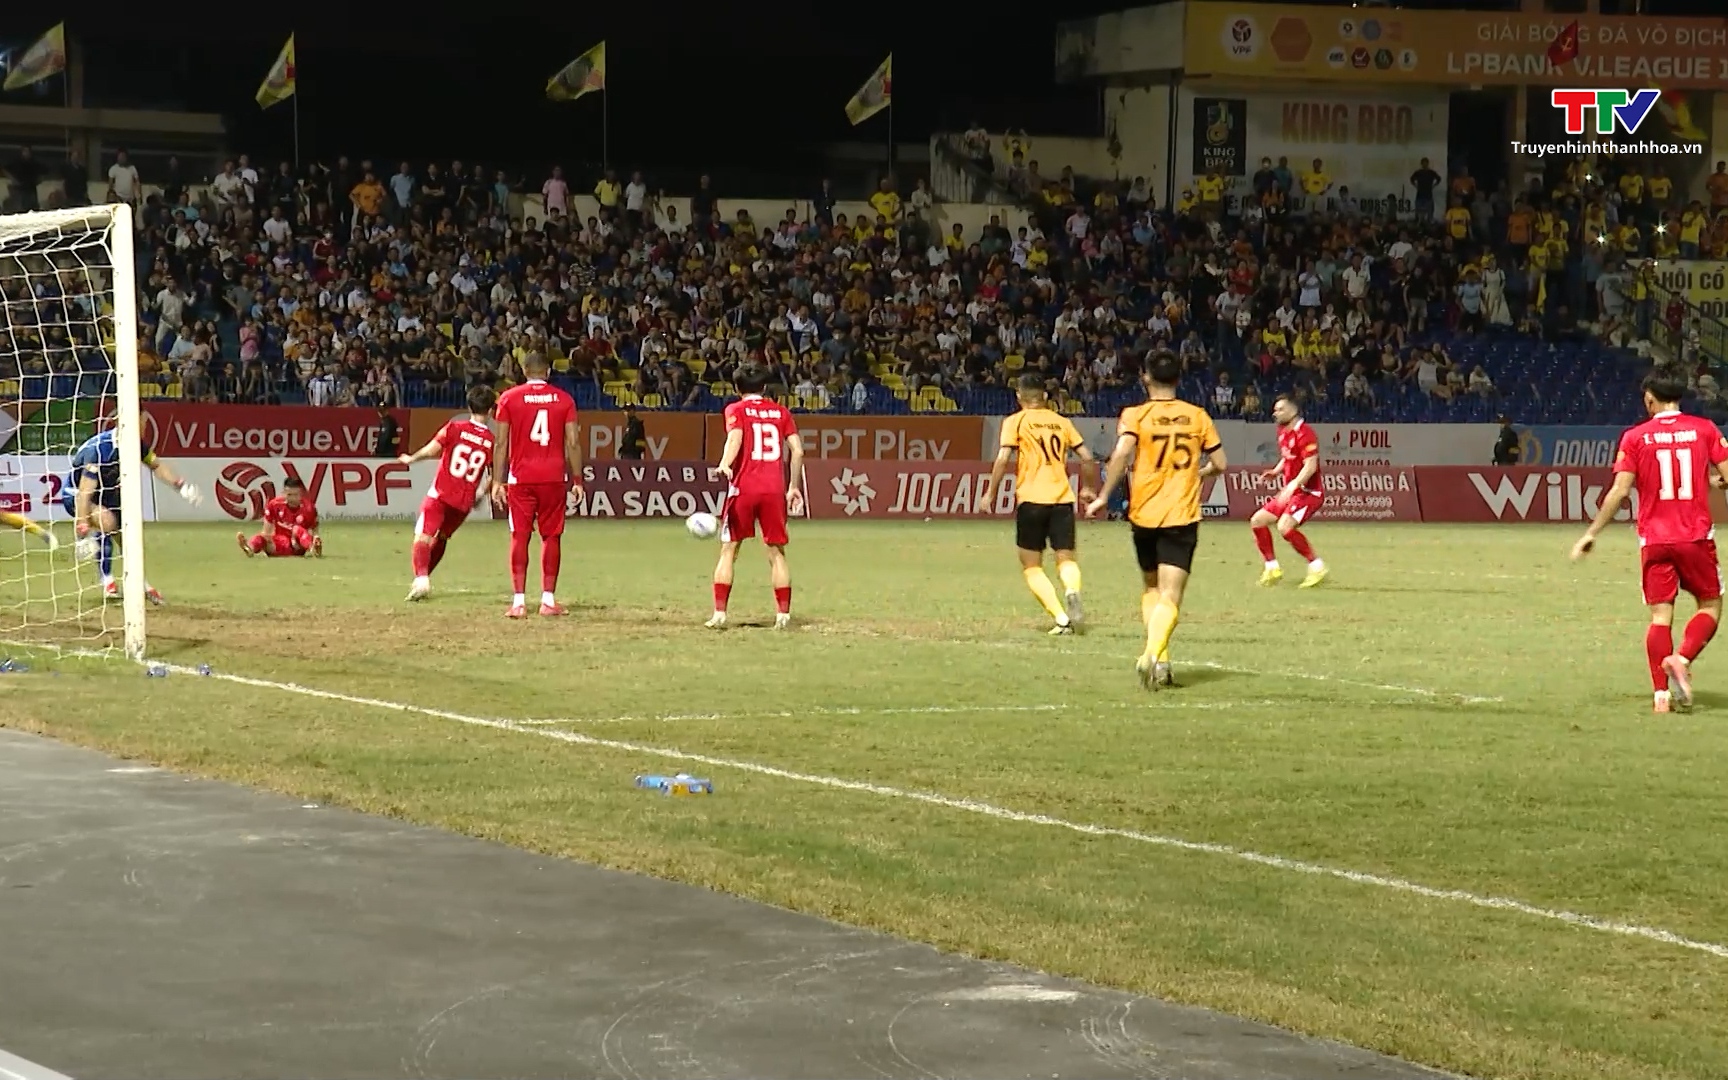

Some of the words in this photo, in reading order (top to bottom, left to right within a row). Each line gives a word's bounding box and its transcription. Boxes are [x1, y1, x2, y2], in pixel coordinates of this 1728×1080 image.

[1478, 17, 1520, 41] GIẢI
[1528, 20, 1590, 43] BÓG
[1598, 22, 1628, 44] ĐÁ
[1637, 23, 1667, 45] VÔ
[1447, 52, 1564, 76] LPBANK
[1573, 55, 1711, 78] V.LEAGUE
[1283, 103, 1348, 143] KING
[1203, 147, 1236, 157] KING
[174, 421, 403, 458] V.League.VP
[530, 409, 550, 446] 4
[590, 424, 669, 460] Ply
[751, 423, 781, 461] 13
[799, 428, 866, 460] FPT
[1349, 429, 1392, 448] PVOIL
[449, 443, 486, 483] 69
[1038, 434, 1061, 464] 10
[1152, 433, 1192, 470] 75
[281, 463, 412, 506] VPF
[1350, 471, 1394, 491] ĐÔNG
[1398, 471, 1410, 492] Á
[1656, 448, 1693, 500] 11
[622, 490, 697, 516] SAO
